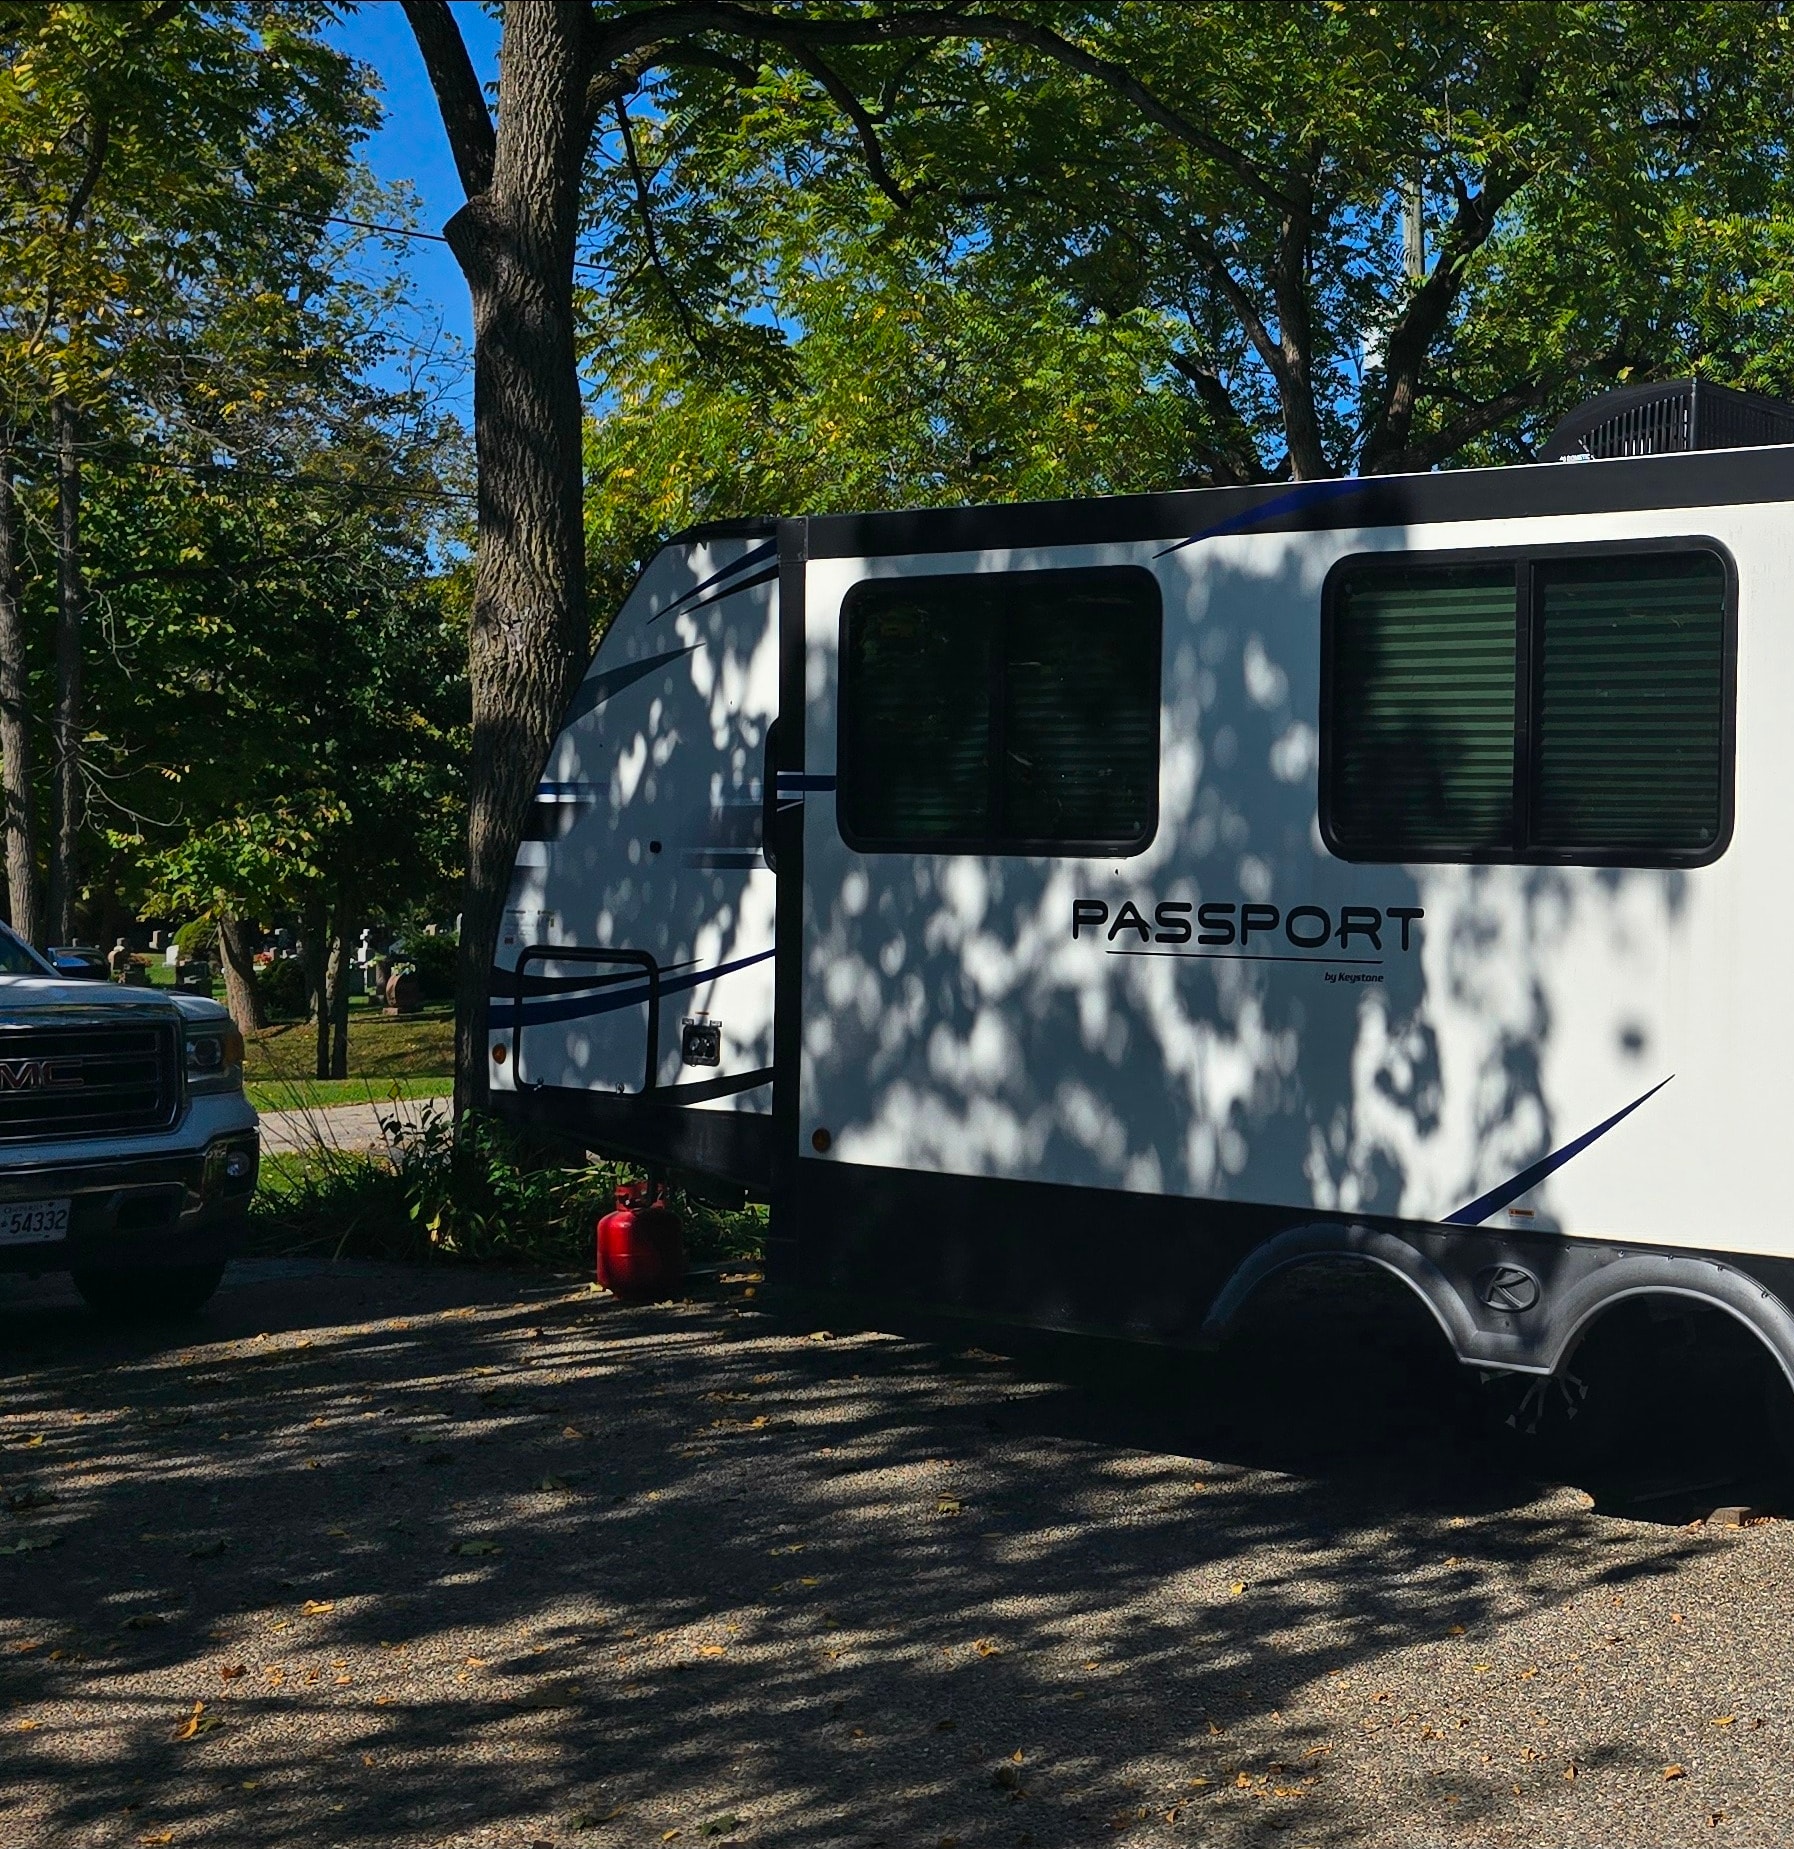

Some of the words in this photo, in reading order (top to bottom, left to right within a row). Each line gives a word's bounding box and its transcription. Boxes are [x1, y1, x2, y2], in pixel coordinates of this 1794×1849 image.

[1072, 899, 1425, 951] PASSPORT
[1324, 972, 1337, 983] by
[1338, 972, 1384, 984] Keystone
[10, 1210, 67, 1234] 54332
